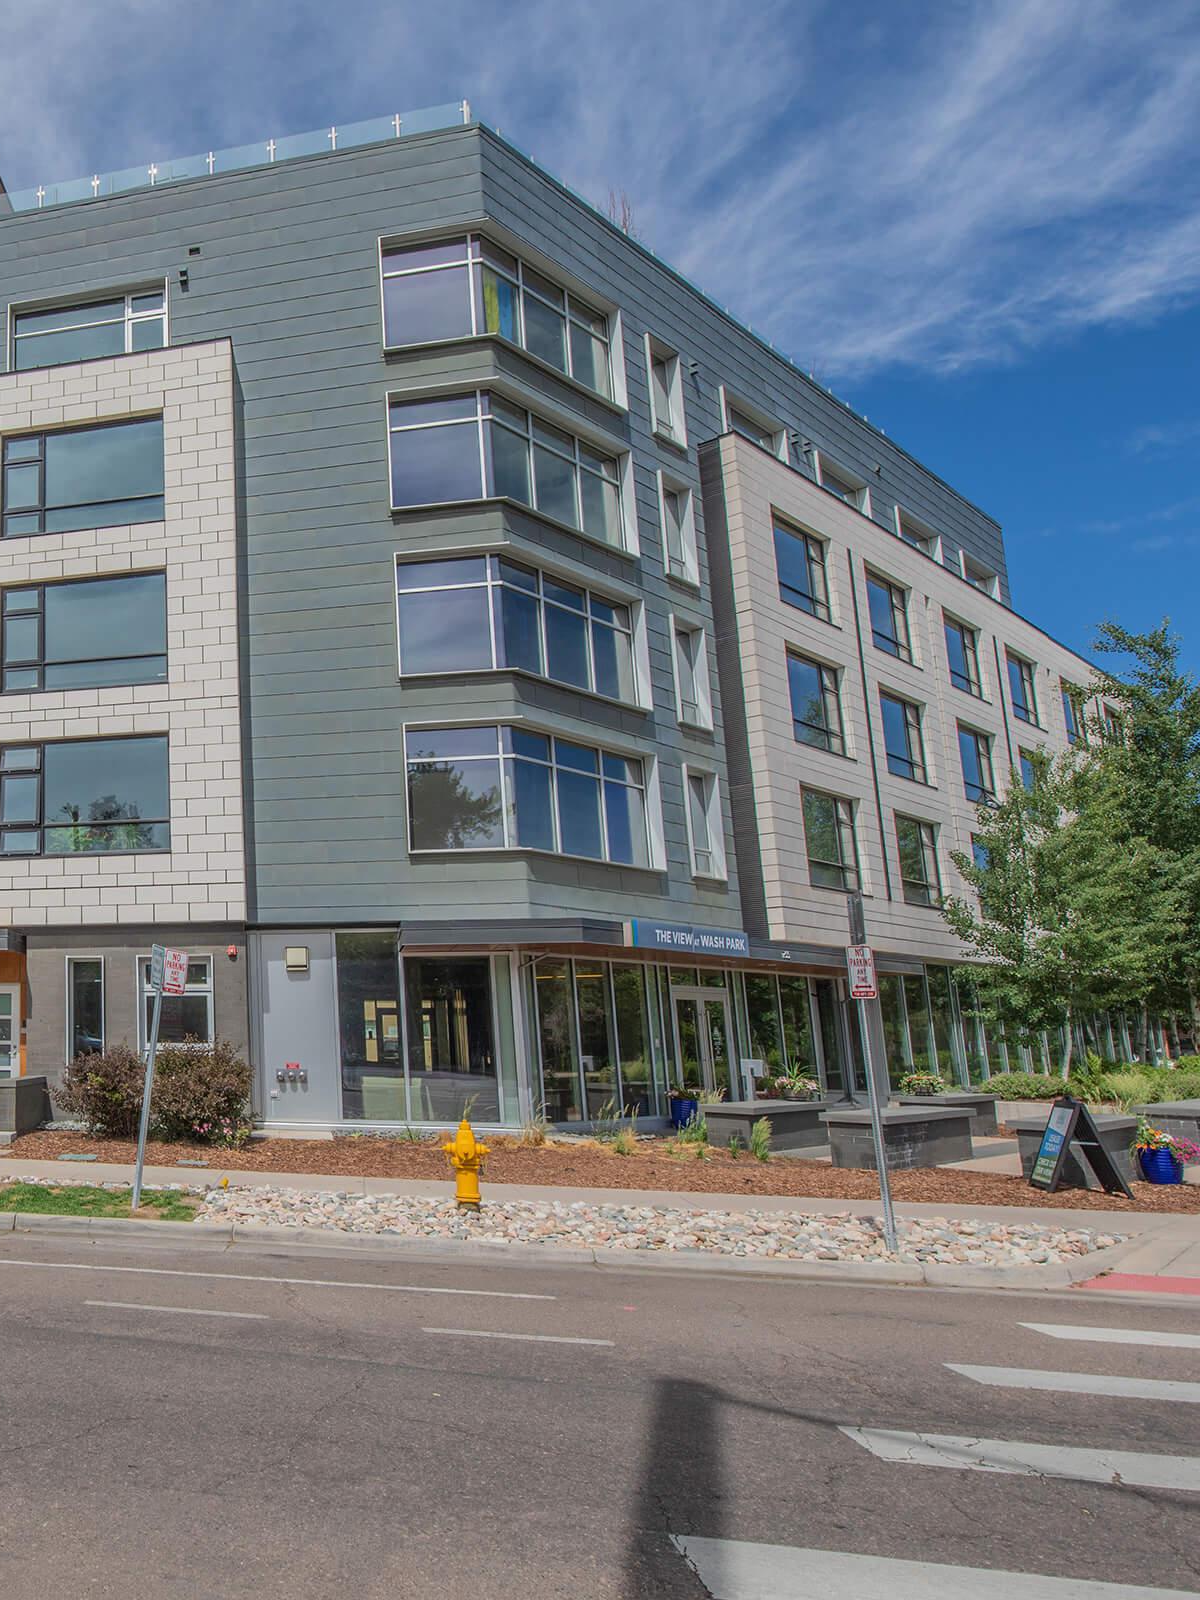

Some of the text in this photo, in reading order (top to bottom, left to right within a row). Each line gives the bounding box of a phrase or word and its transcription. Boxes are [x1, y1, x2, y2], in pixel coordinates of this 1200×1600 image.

[655, 929, 672, 944] THE
[672, 931, 693, 946] VIEW
[700, 935, 724, 948] WASH
[725, 937, 745, 951] PARK
[855, 948, 864, 957] NO
[172, 953, 181, 962] NO
[167, 960, 185, 972] PARKING
[848, 958, 872, 967] PARKING
